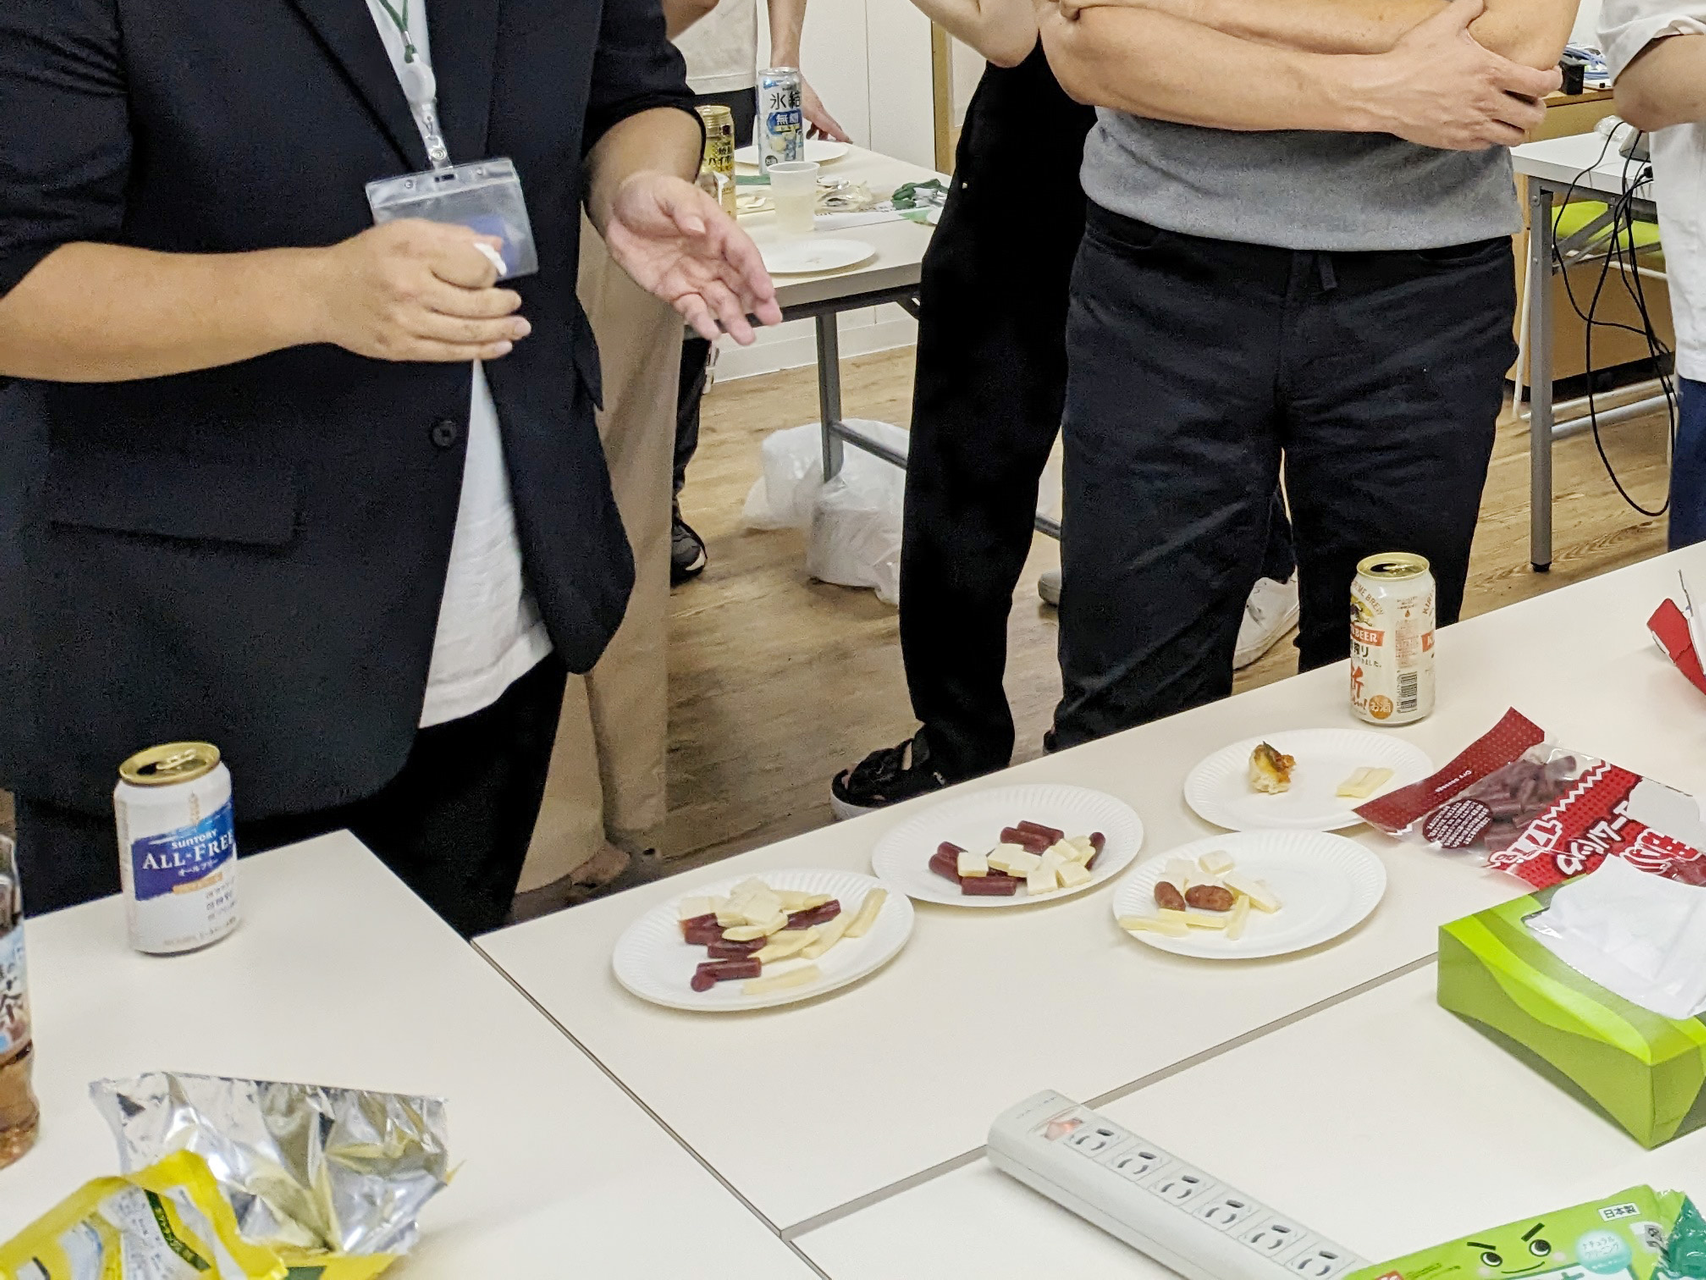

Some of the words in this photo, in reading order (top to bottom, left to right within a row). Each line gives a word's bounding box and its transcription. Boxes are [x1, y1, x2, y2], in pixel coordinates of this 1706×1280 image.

[1371, 700, 1391, 714] お酒
[172, 828, 218, 849] SUNTORY
[1603, 1204, 1637, 1219] 日本製
